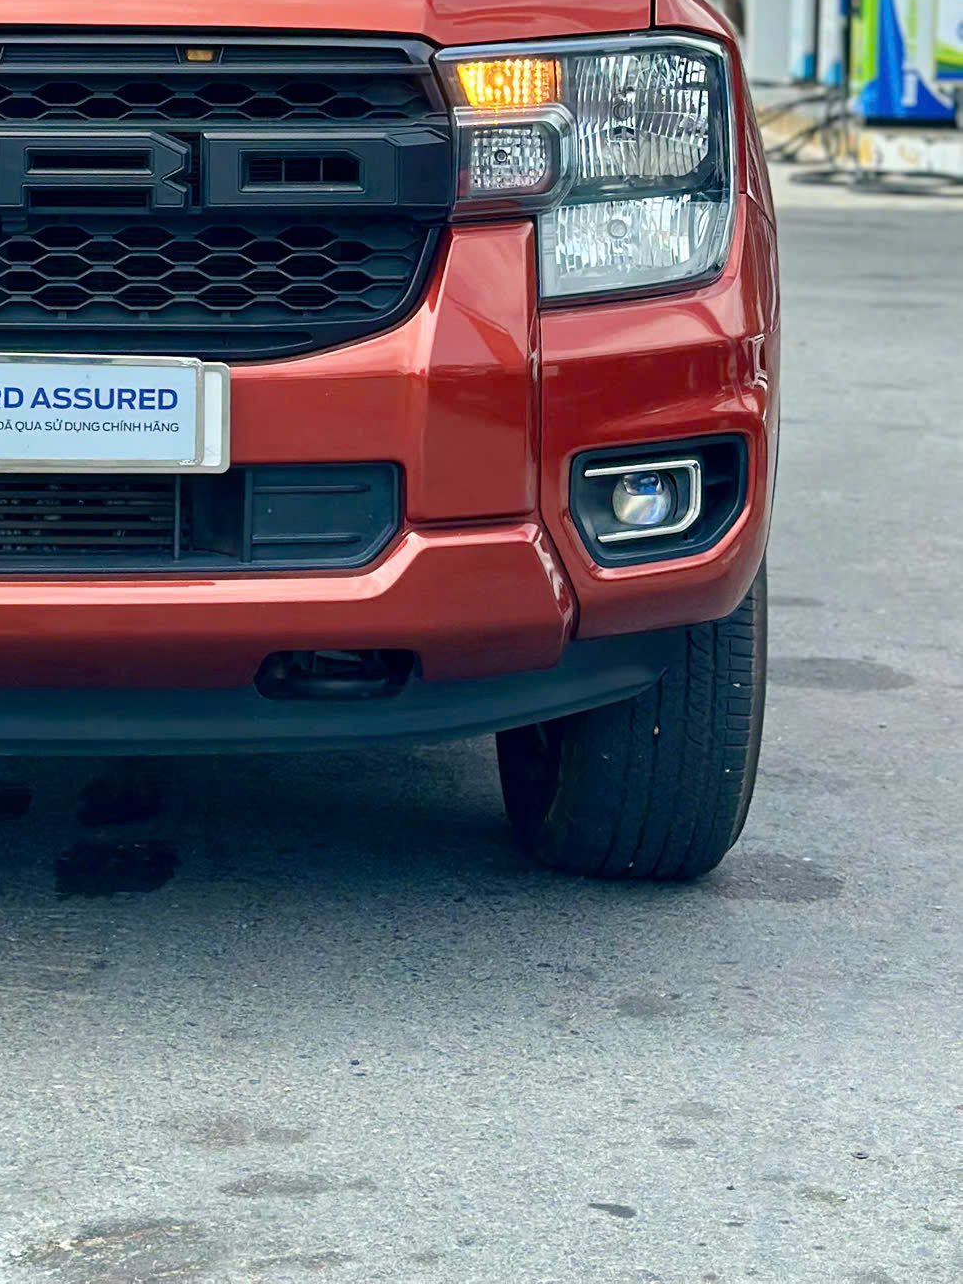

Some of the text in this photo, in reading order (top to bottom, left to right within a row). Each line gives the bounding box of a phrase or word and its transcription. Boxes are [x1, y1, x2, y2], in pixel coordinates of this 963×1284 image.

[30, 387, 178, 410] ASSURED
[15, 420, 42, 432] QUA
[64, 421, 101, 434] DỤNG
[102, 419, 141, 432] CHÍNH
